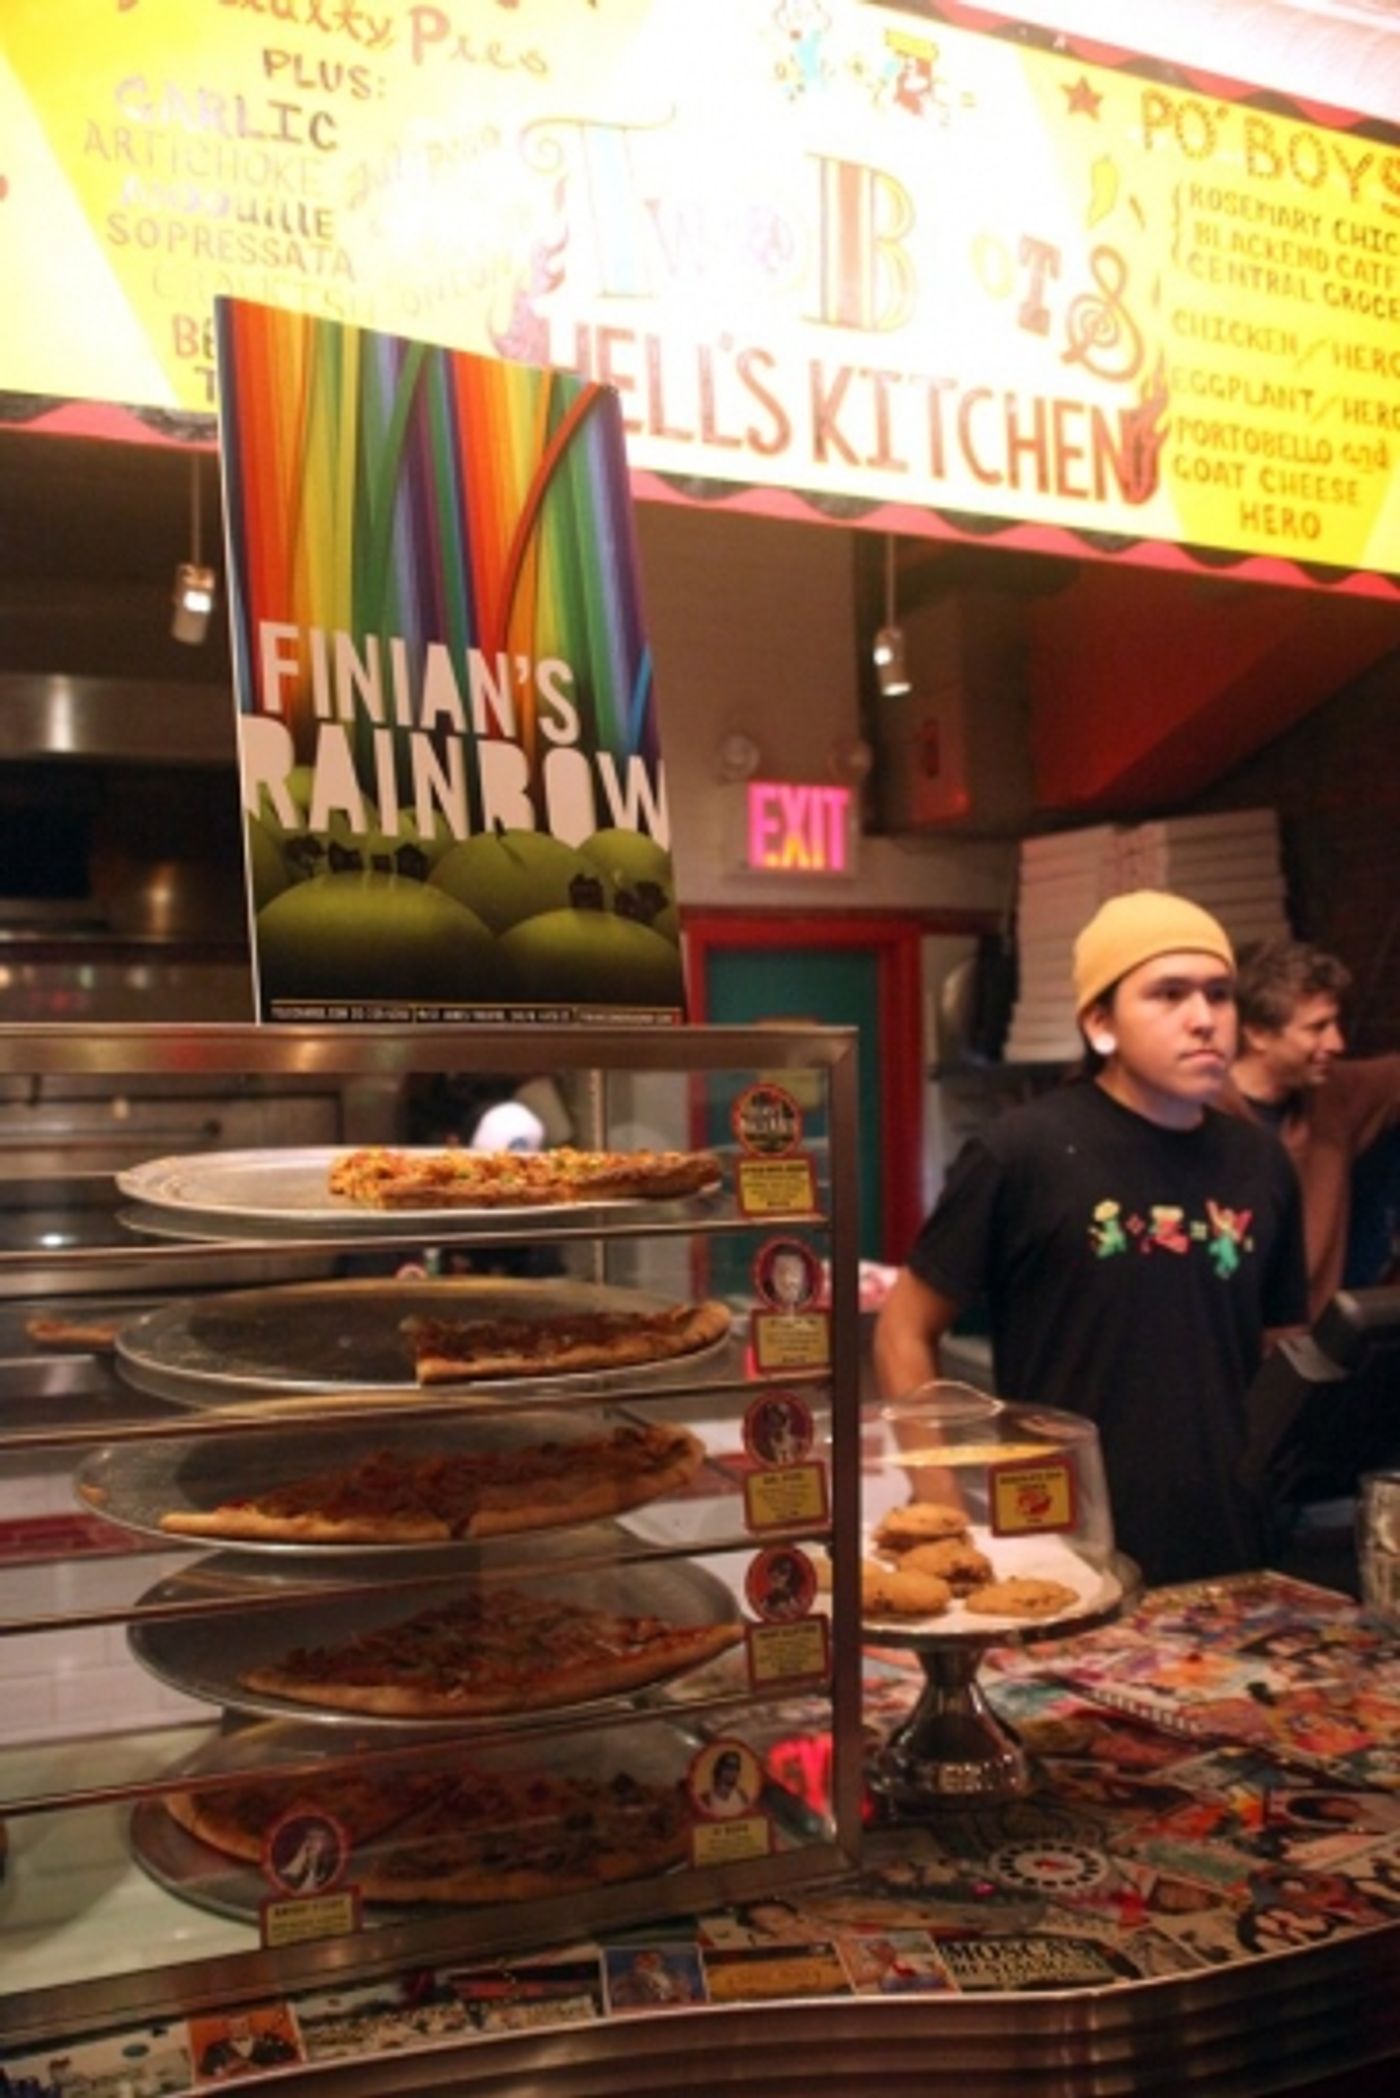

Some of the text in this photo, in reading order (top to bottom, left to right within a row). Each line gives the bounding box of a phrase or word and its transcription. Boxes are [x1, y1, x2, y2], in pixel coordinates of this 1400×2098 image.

[263, 47, 388, 100] PLUS:
[114, 75, 340, 154] GARLIC
[83, 118, 323, 196] ARTICHOKE
[105, 209, 357, 284] SOPRESSATA
[1190, 183, 1323, 238] ROSEMARY
[1187, 251, 1314, 303] CENTRAL
[805, 358, 1158, 504] KITCHEN
[1177, 415, 1334, 465] PORTOBELLO
[1240, 500, 1322, 541] HERO
[1259, 466, 1360, 507] CHEESE
[258, 620, 580, 746] FINIAN'S
[240, 714, 672, 850] RAINBOW
[748, 782, 853, 872] EXIT
